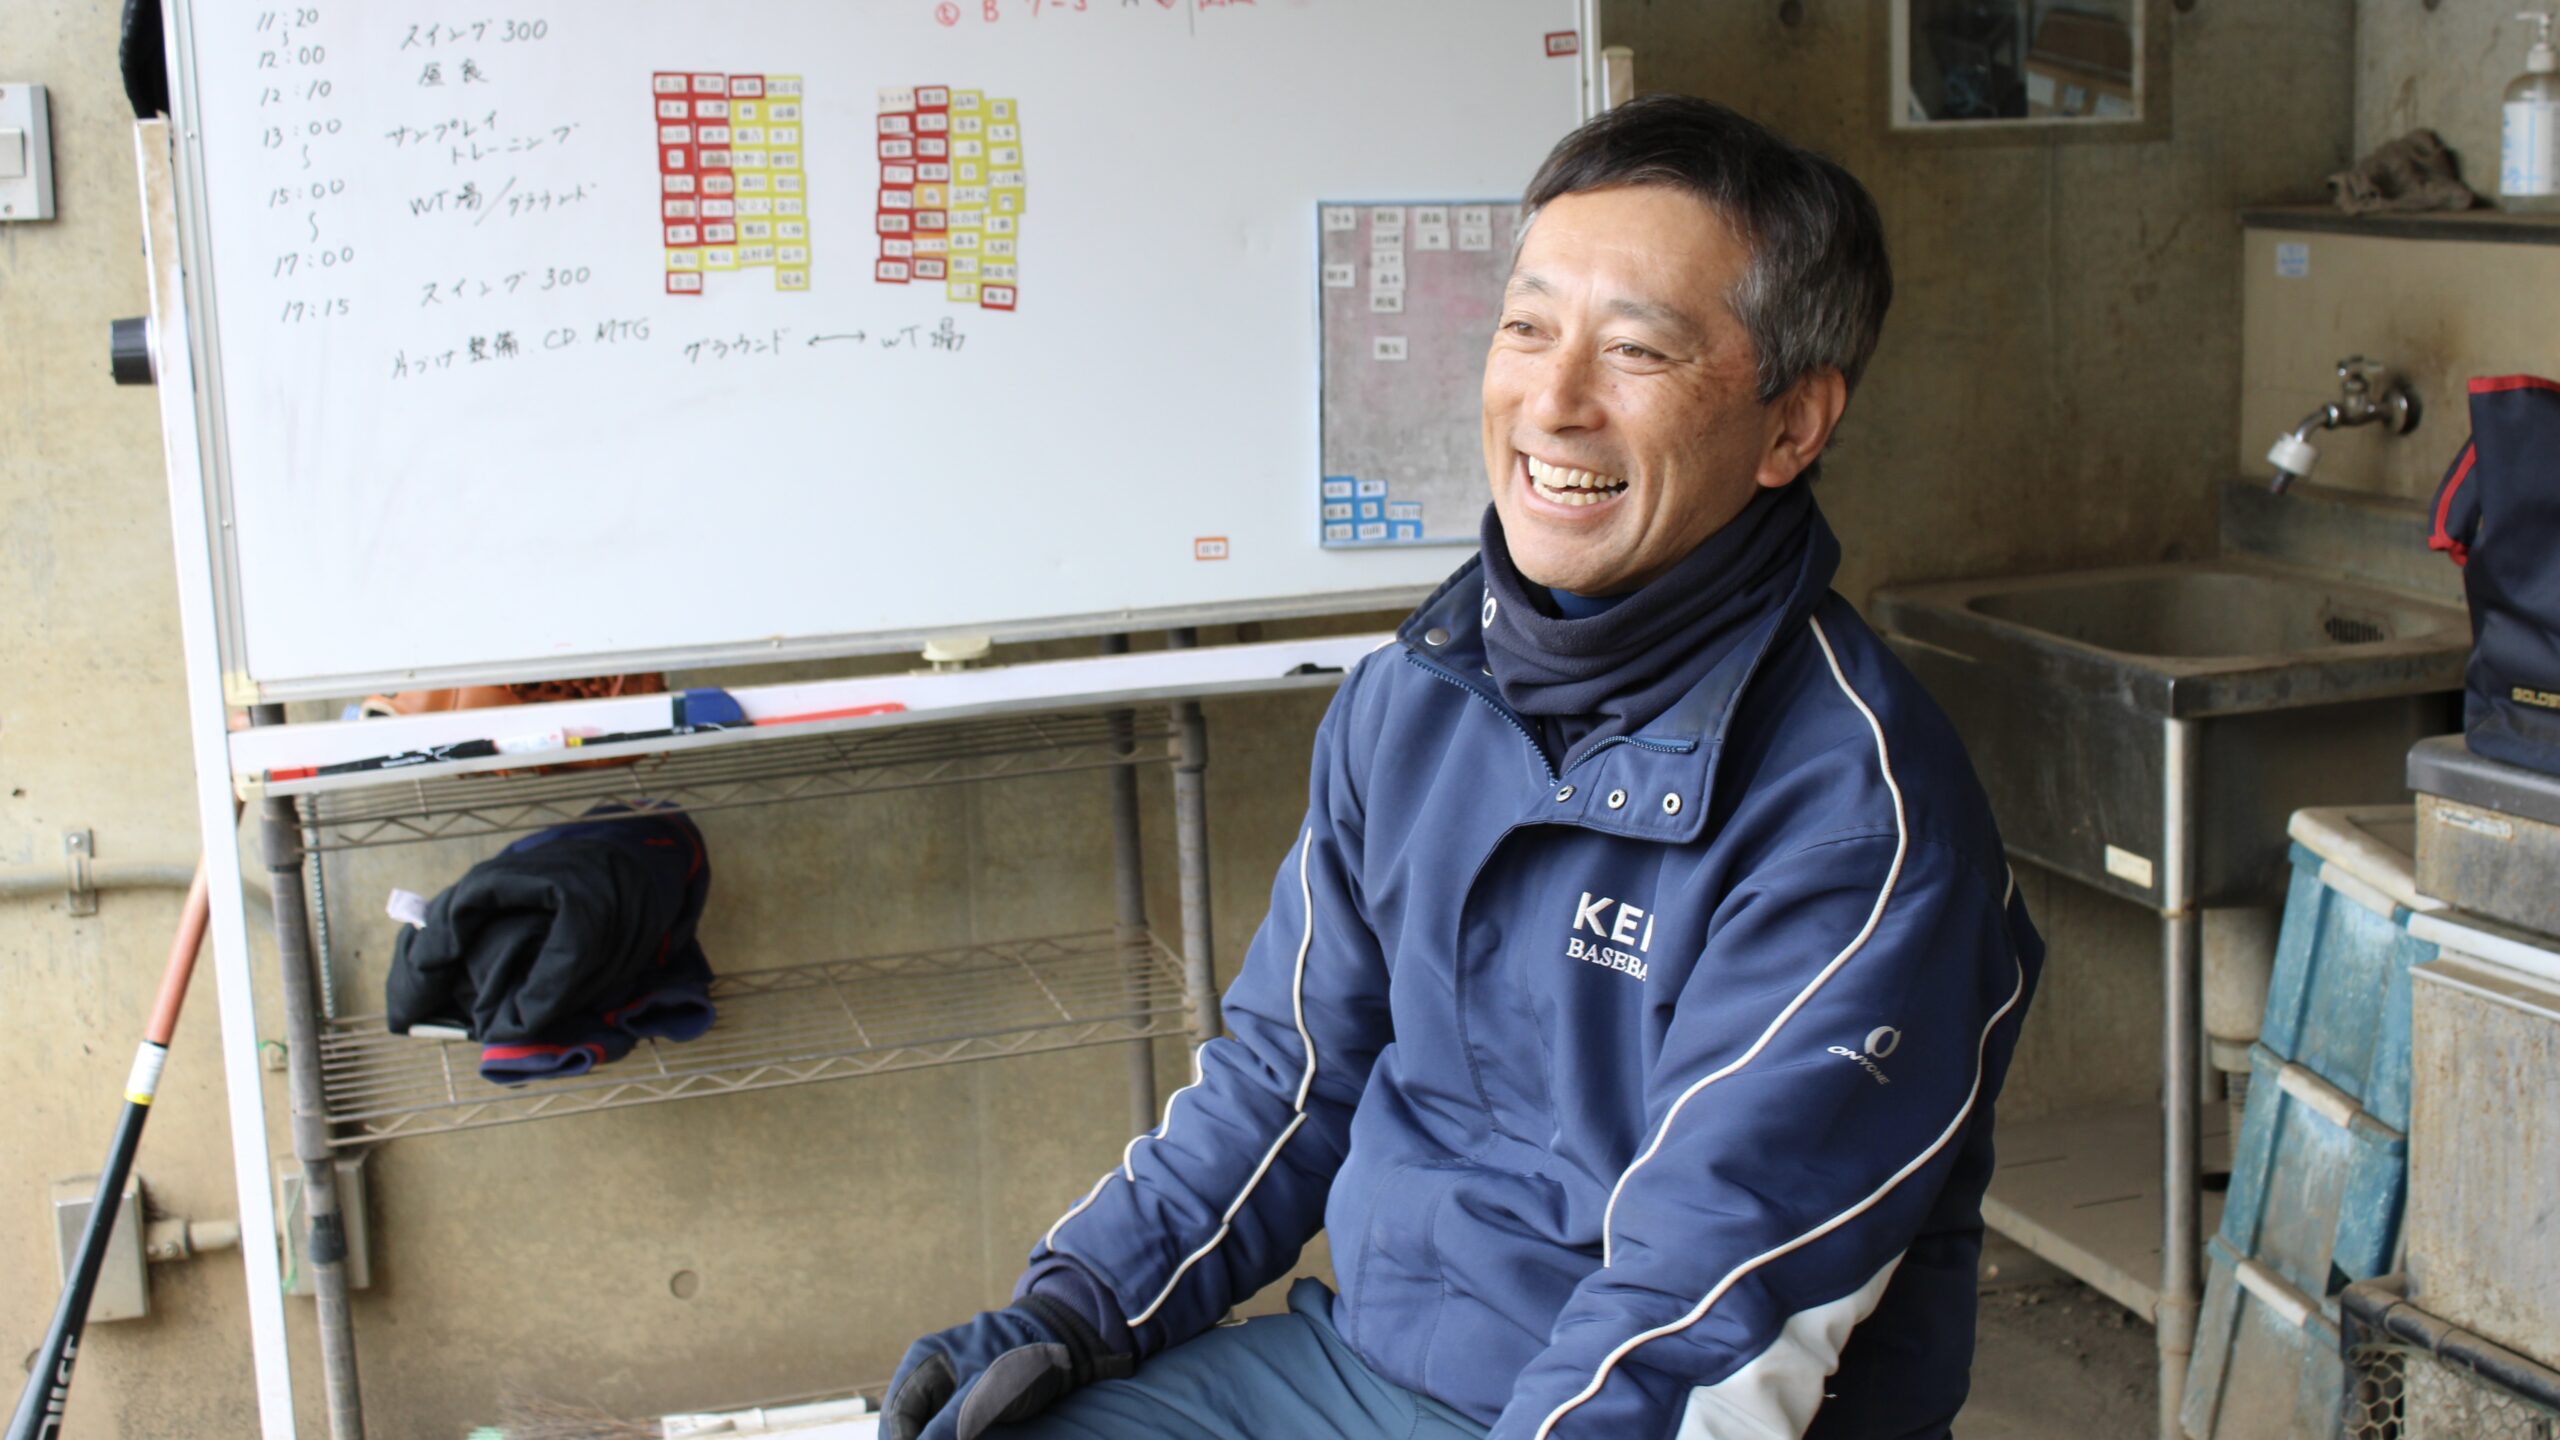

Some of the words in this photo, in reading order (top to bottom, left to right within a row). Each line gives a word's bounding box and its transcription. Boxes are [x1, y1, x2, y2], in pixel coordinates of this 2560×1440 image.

[257, 8, 319, 32] 11:20
[502, 19, 547, 42] 300
[259, 45, 325, 69] 12:00
[261, 80, 332, 107] 12:10
[264, 118, 342, 148] 13:00
[270, 179, 345, 208] 15:00
[274, 246, 354, 278] 17:00
[541, 267, 590, 291] 300
[282, 298, 350, 323] 17:15
